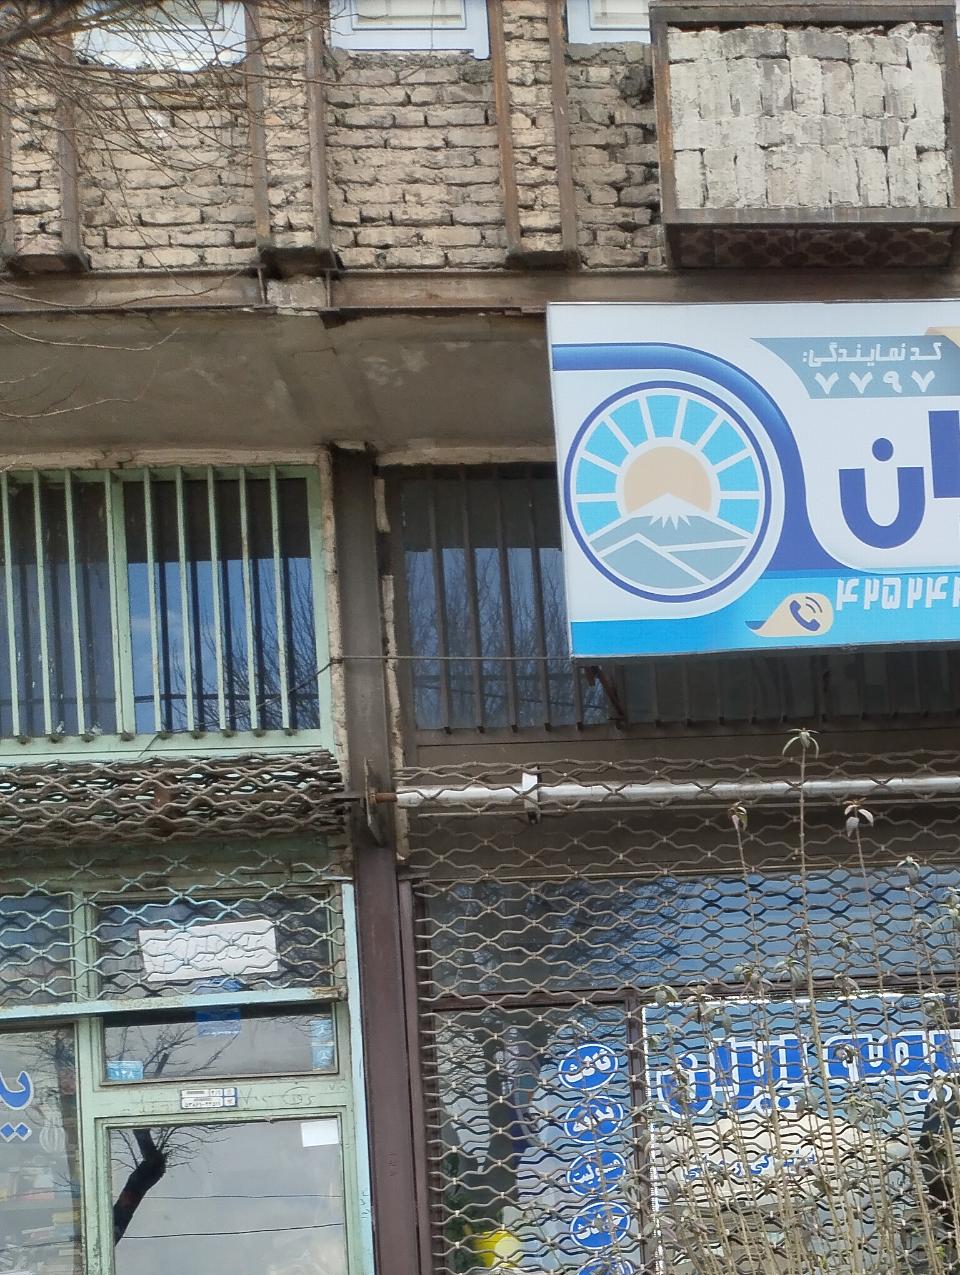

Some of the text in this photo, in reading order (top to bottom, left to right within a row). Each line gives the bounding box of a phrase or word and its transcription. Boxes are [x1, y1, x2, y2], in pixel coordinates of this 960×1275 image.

[802, 342, 943, 368] کد نمایندگی:
[814, 370, 936, 395] ۷۷۹۷
